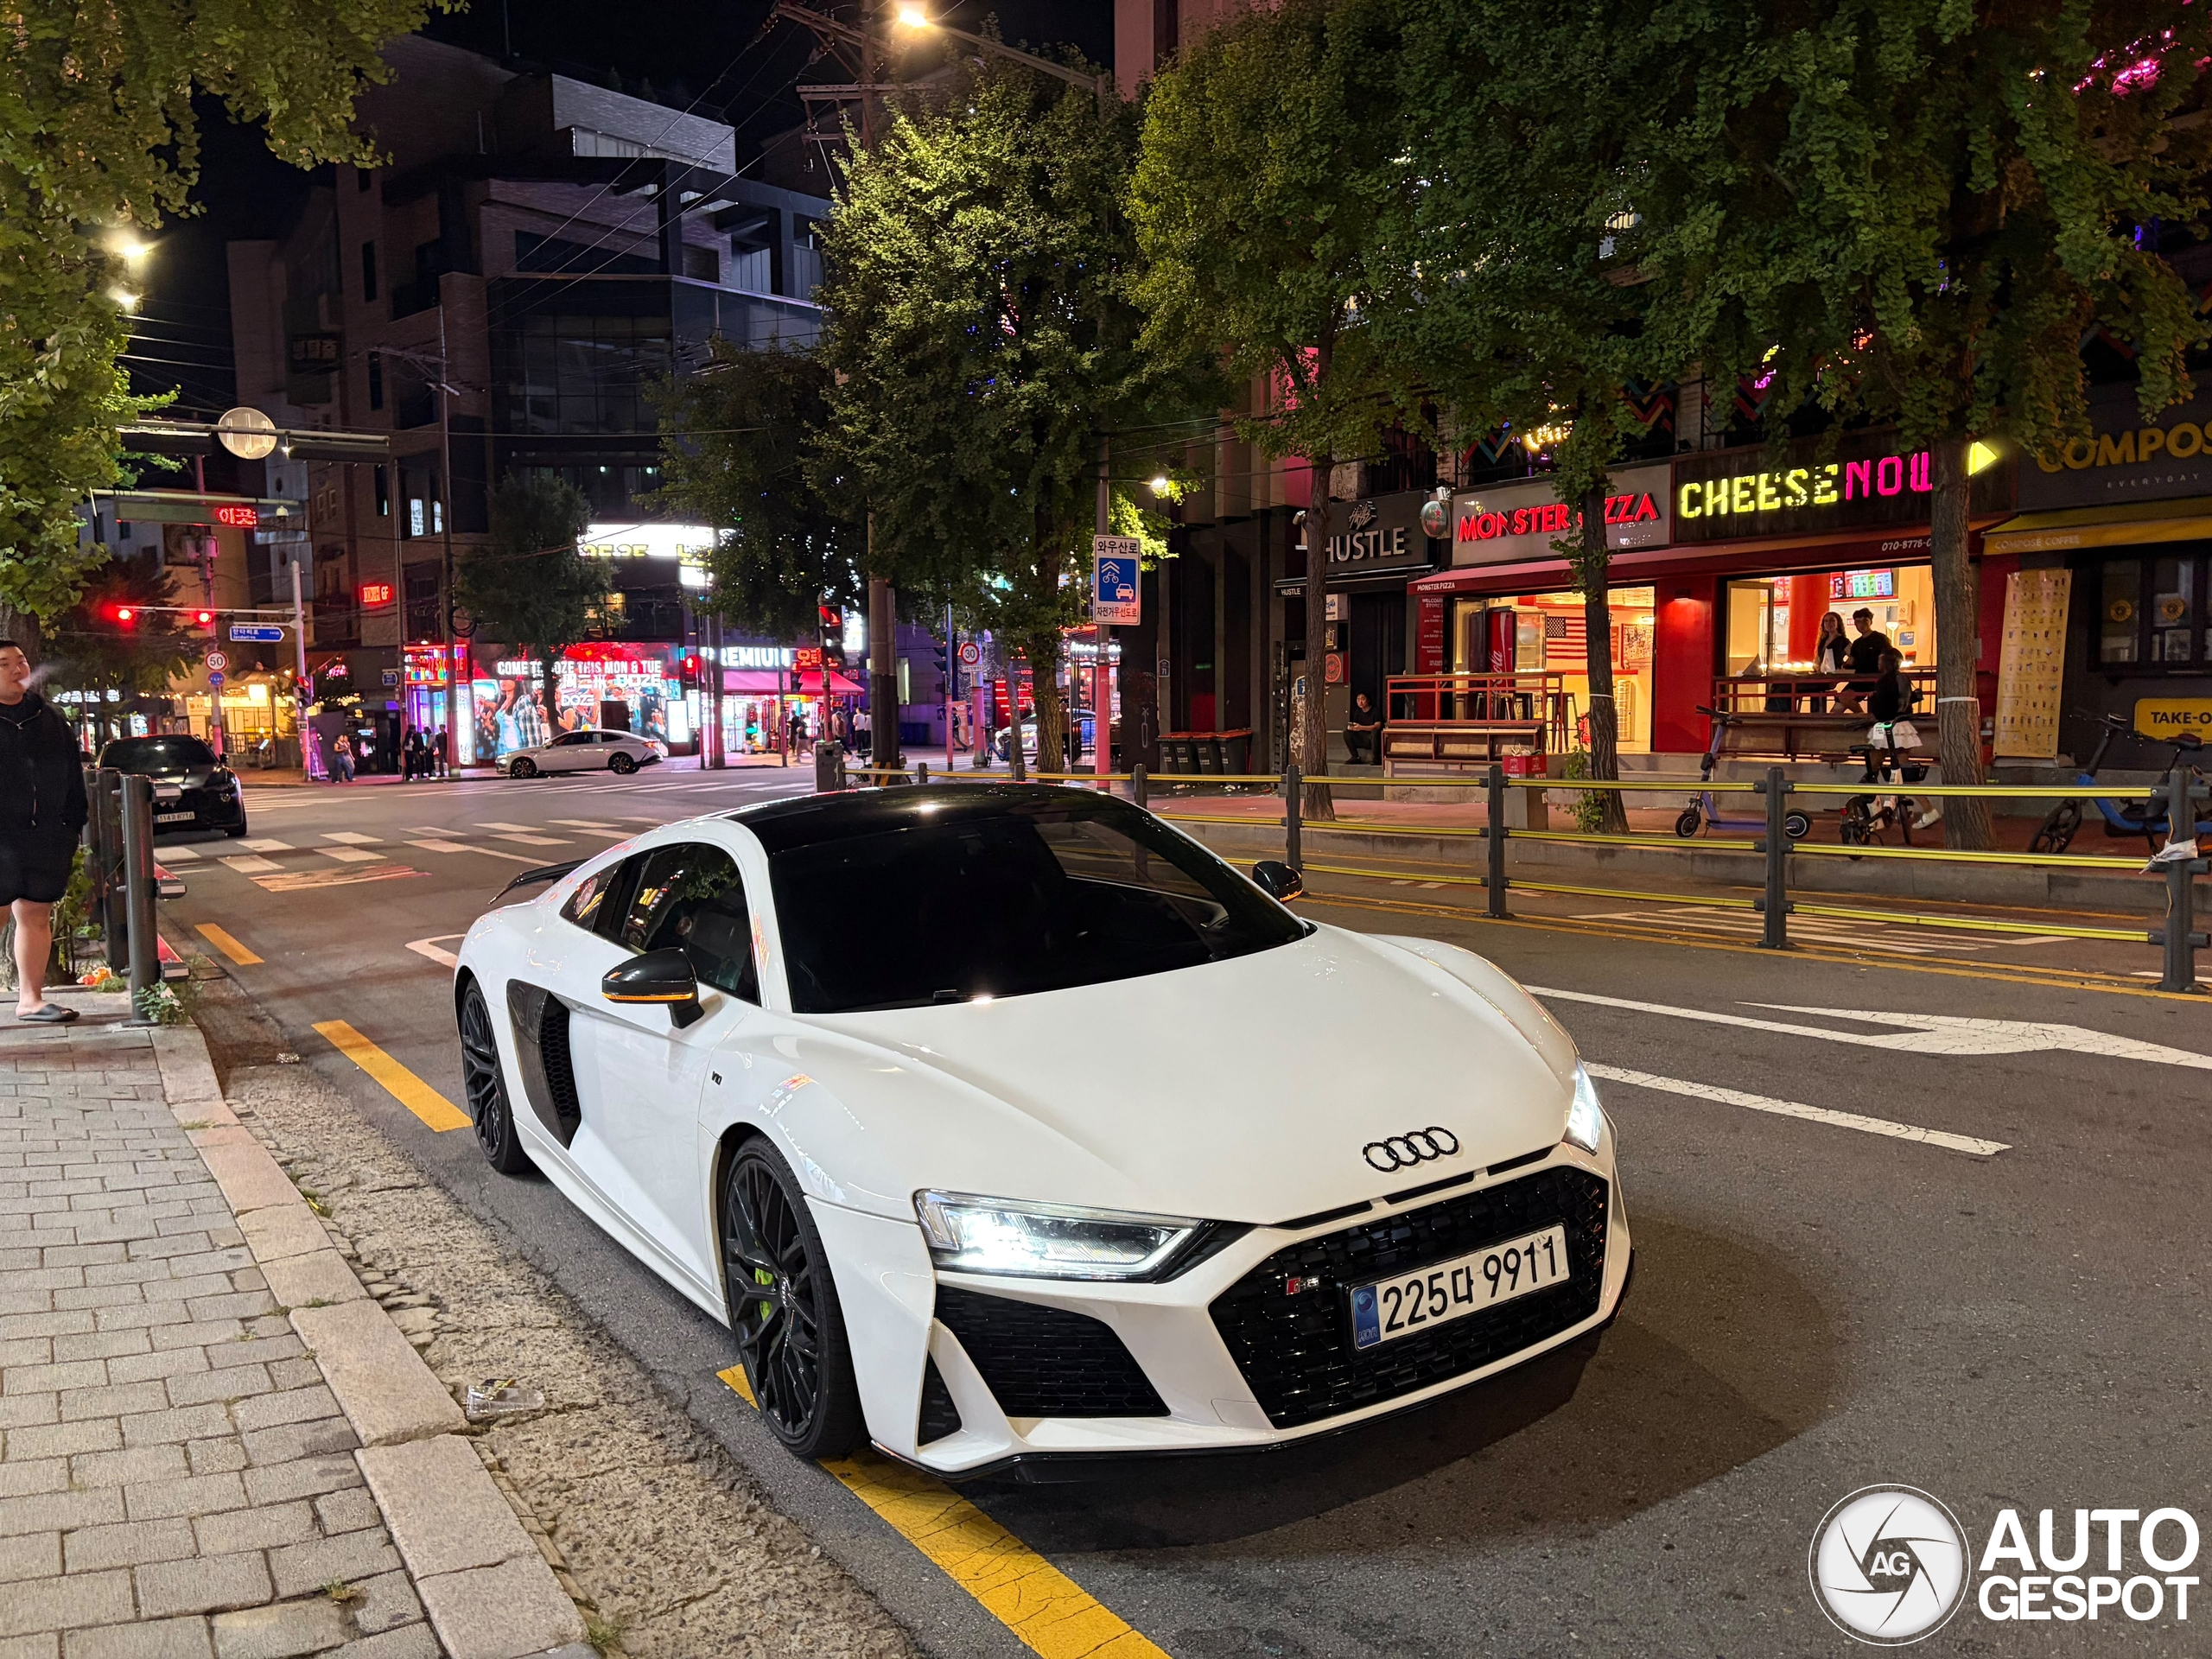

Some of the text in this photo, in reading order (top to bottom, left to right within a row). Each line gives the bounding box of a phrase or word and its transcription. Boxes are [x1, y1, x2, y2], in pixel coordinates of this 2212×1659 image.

[2107, 473, 2200, 489] EVERYDAY
[1458, 503, 1572, 543] MONSTER
[1096, 540, 1138, 555] 와우산로
[1995, 535, 2080, 550] COMPOSE COFFEE
[1281, 588, 1301, 596] HUSTLE
[1417, 582, 1456, 592] MONSTER PIZZA
[1096, 606, 1137, 618] 자전거우선도로
[964, 649, 976, 658] 30
[209, 657, 224, 666] 50
[497, 661, 526, 676] COME
[577, 660, 601, 674] THIS
[605, 660, 627, 674] MON
[641, 660, 662, 673] TUE
[562, 695, 594, 706] DOZE
[1382, 1236, 1557, 1333] 225다 9911
[1357, 1325, 1378, 1343] KOR
